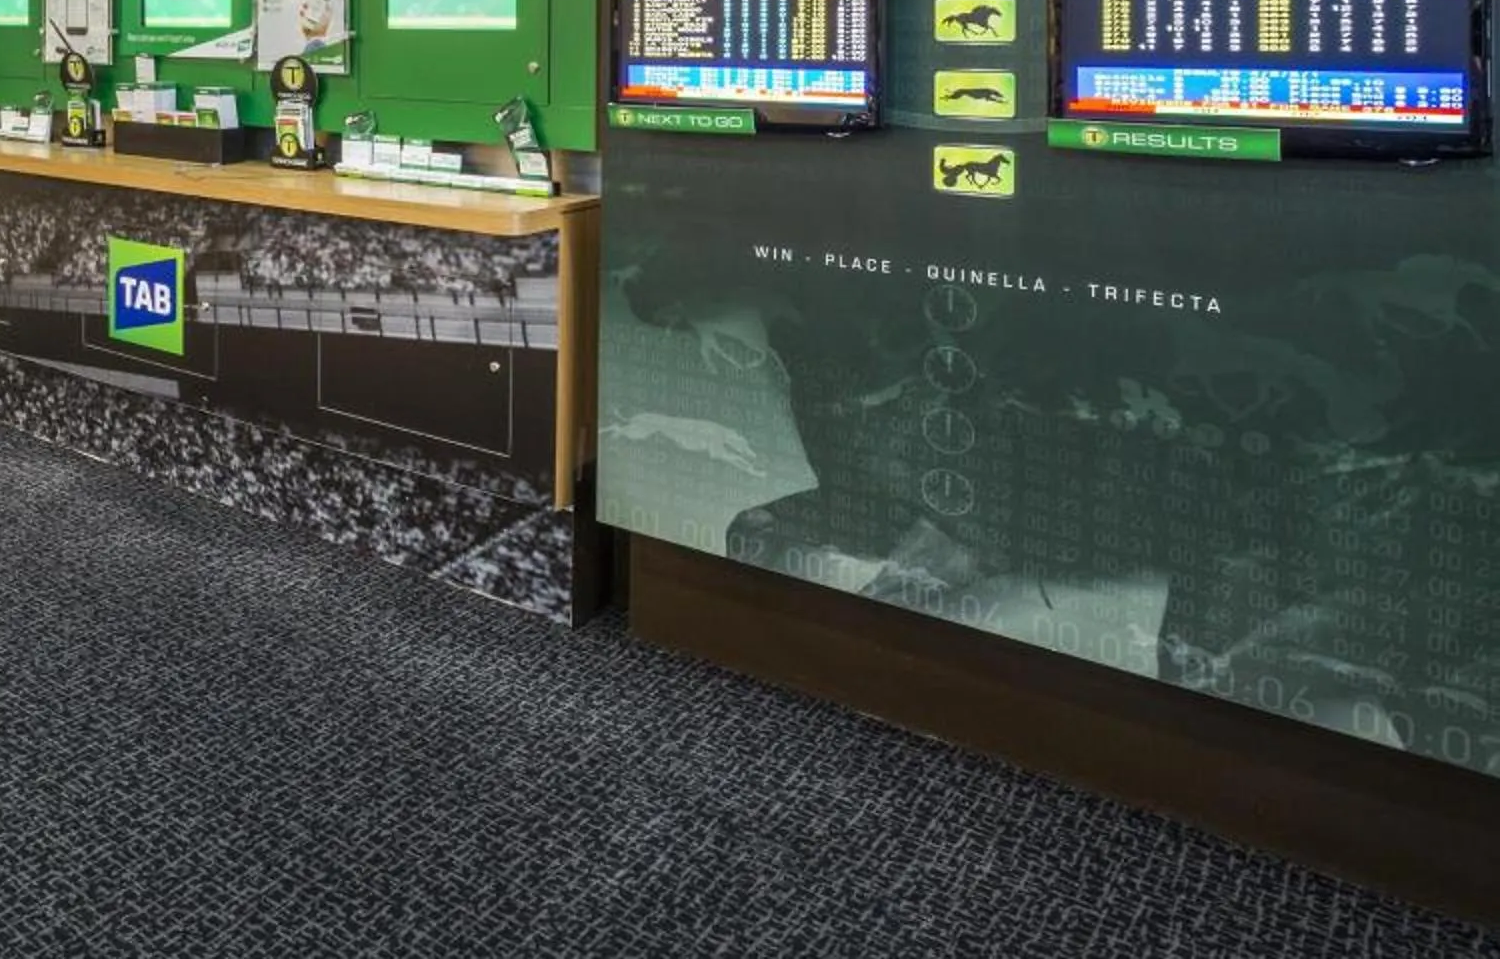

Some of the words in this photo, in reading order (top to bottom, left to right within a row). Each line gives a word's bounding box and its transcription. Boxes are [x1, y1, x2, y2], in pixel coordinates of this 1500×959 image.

[638, 112, 682, 126] NEXT
[689, 114, 713, 126] TO
[715, 116, 743, 128] GO
[1113, 132, 1238, 152] RESULTS
[753, 246, 793, 262] WIN
[825, 253, 892, 274] PLACE
[927, 264, 1046, 292] QUINELLA
[1087, 283, 1222, 313] TRIFECTA
[120, 276, 171, 316] TAB
